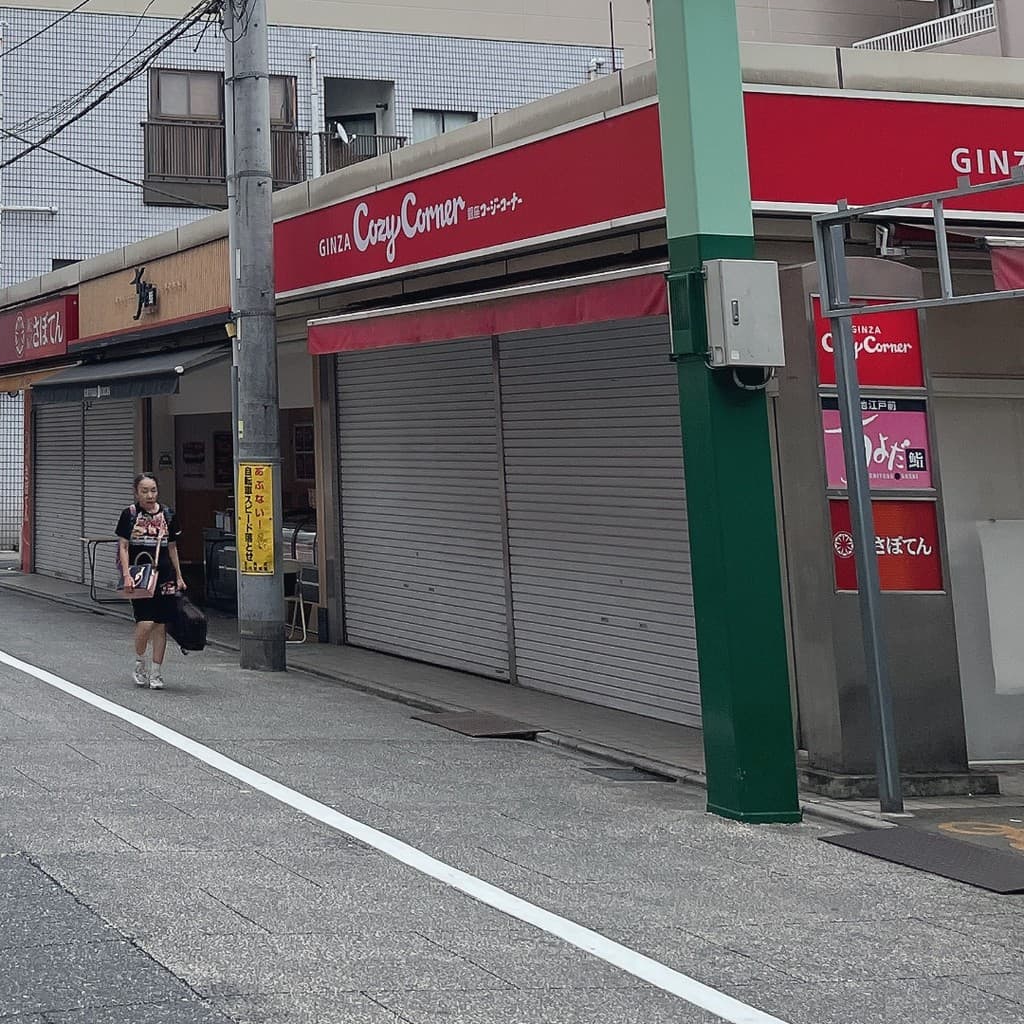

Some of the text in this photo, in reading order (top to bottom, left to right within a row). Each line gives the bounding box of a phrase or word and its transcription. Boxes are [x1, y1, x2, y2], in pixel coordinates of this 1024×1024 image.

[319, 233, 352, 257] GINZA
[352, 201, 402, 263] Cozy
[400, 191, 466, 238] Corner
[32, 311, 63, 349] さぼてん
[863, 335, 913, 354] Corner
[874, 535, 933, 556] さぼてん
